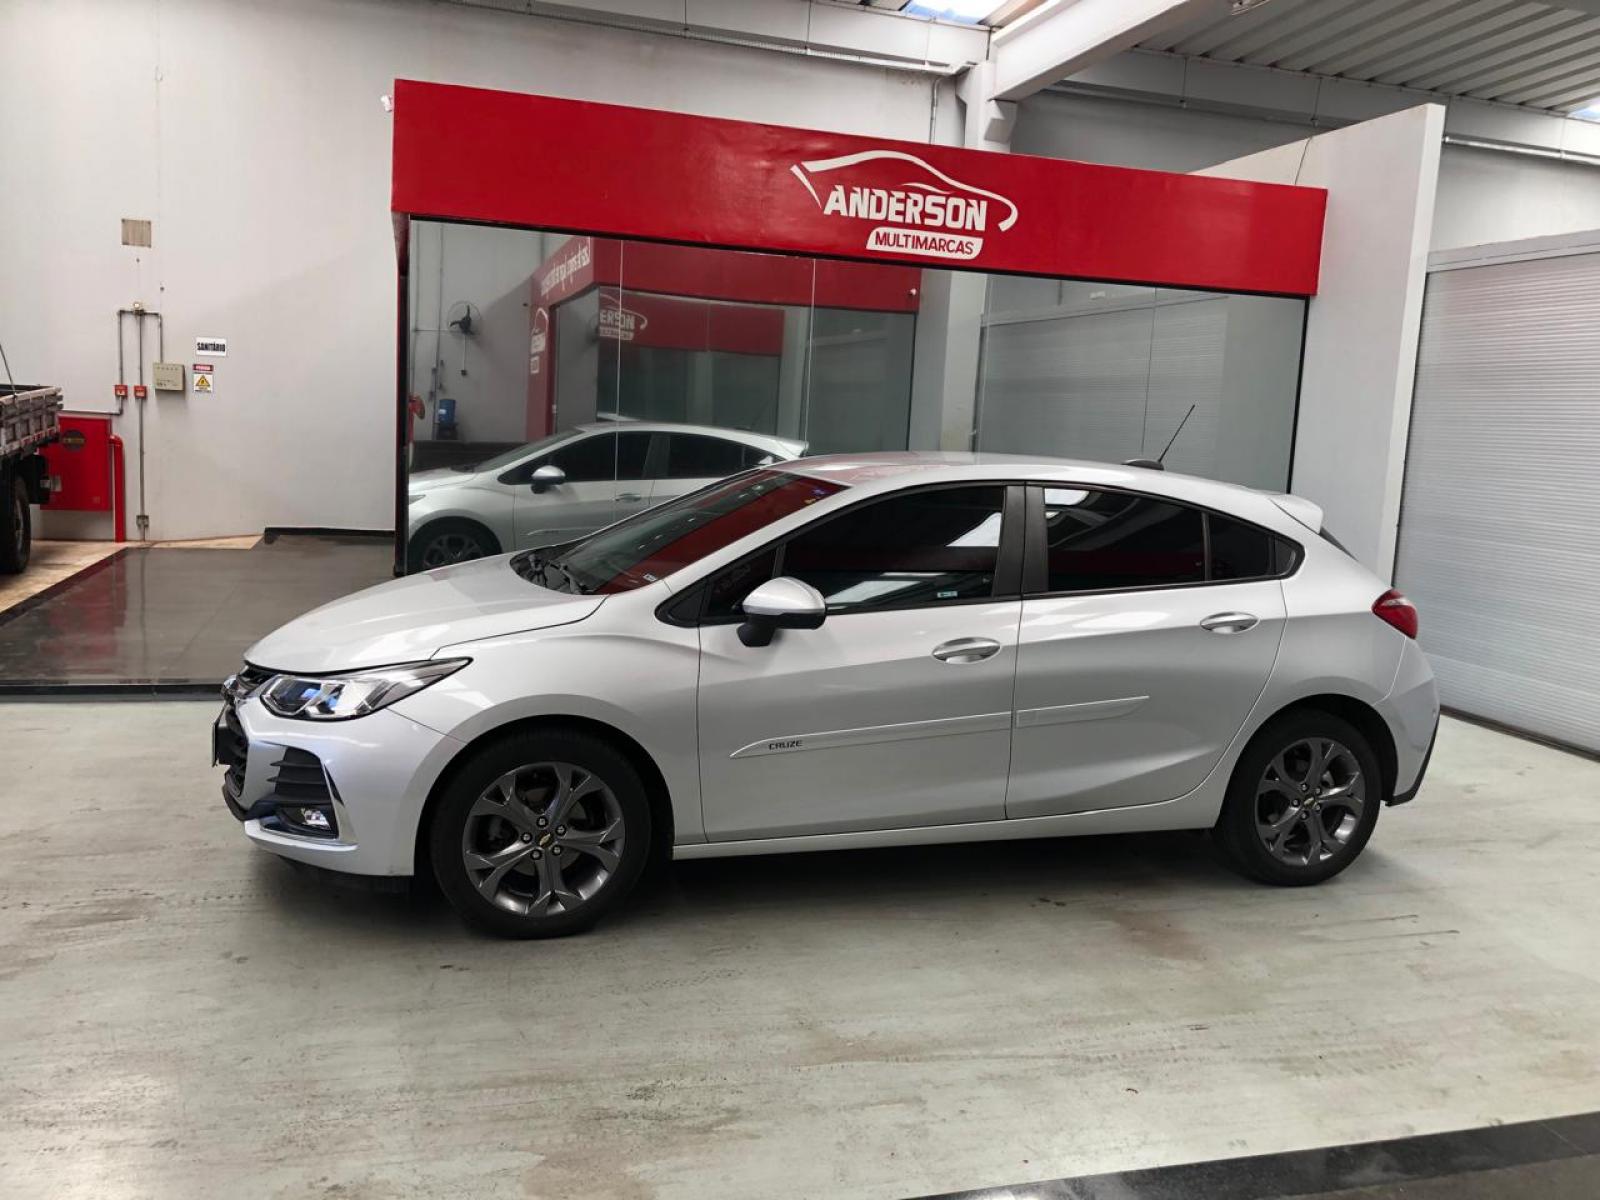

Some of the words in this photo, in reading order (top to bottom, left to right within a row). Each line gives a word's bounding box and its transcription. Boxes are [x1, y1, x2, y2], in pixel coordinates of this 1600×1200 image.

[823, 184, 988, 232] ANDERSON
[874, 230, 974, 256] MULTIMARCAS
[768, 740, 803, 750] CRUZE
